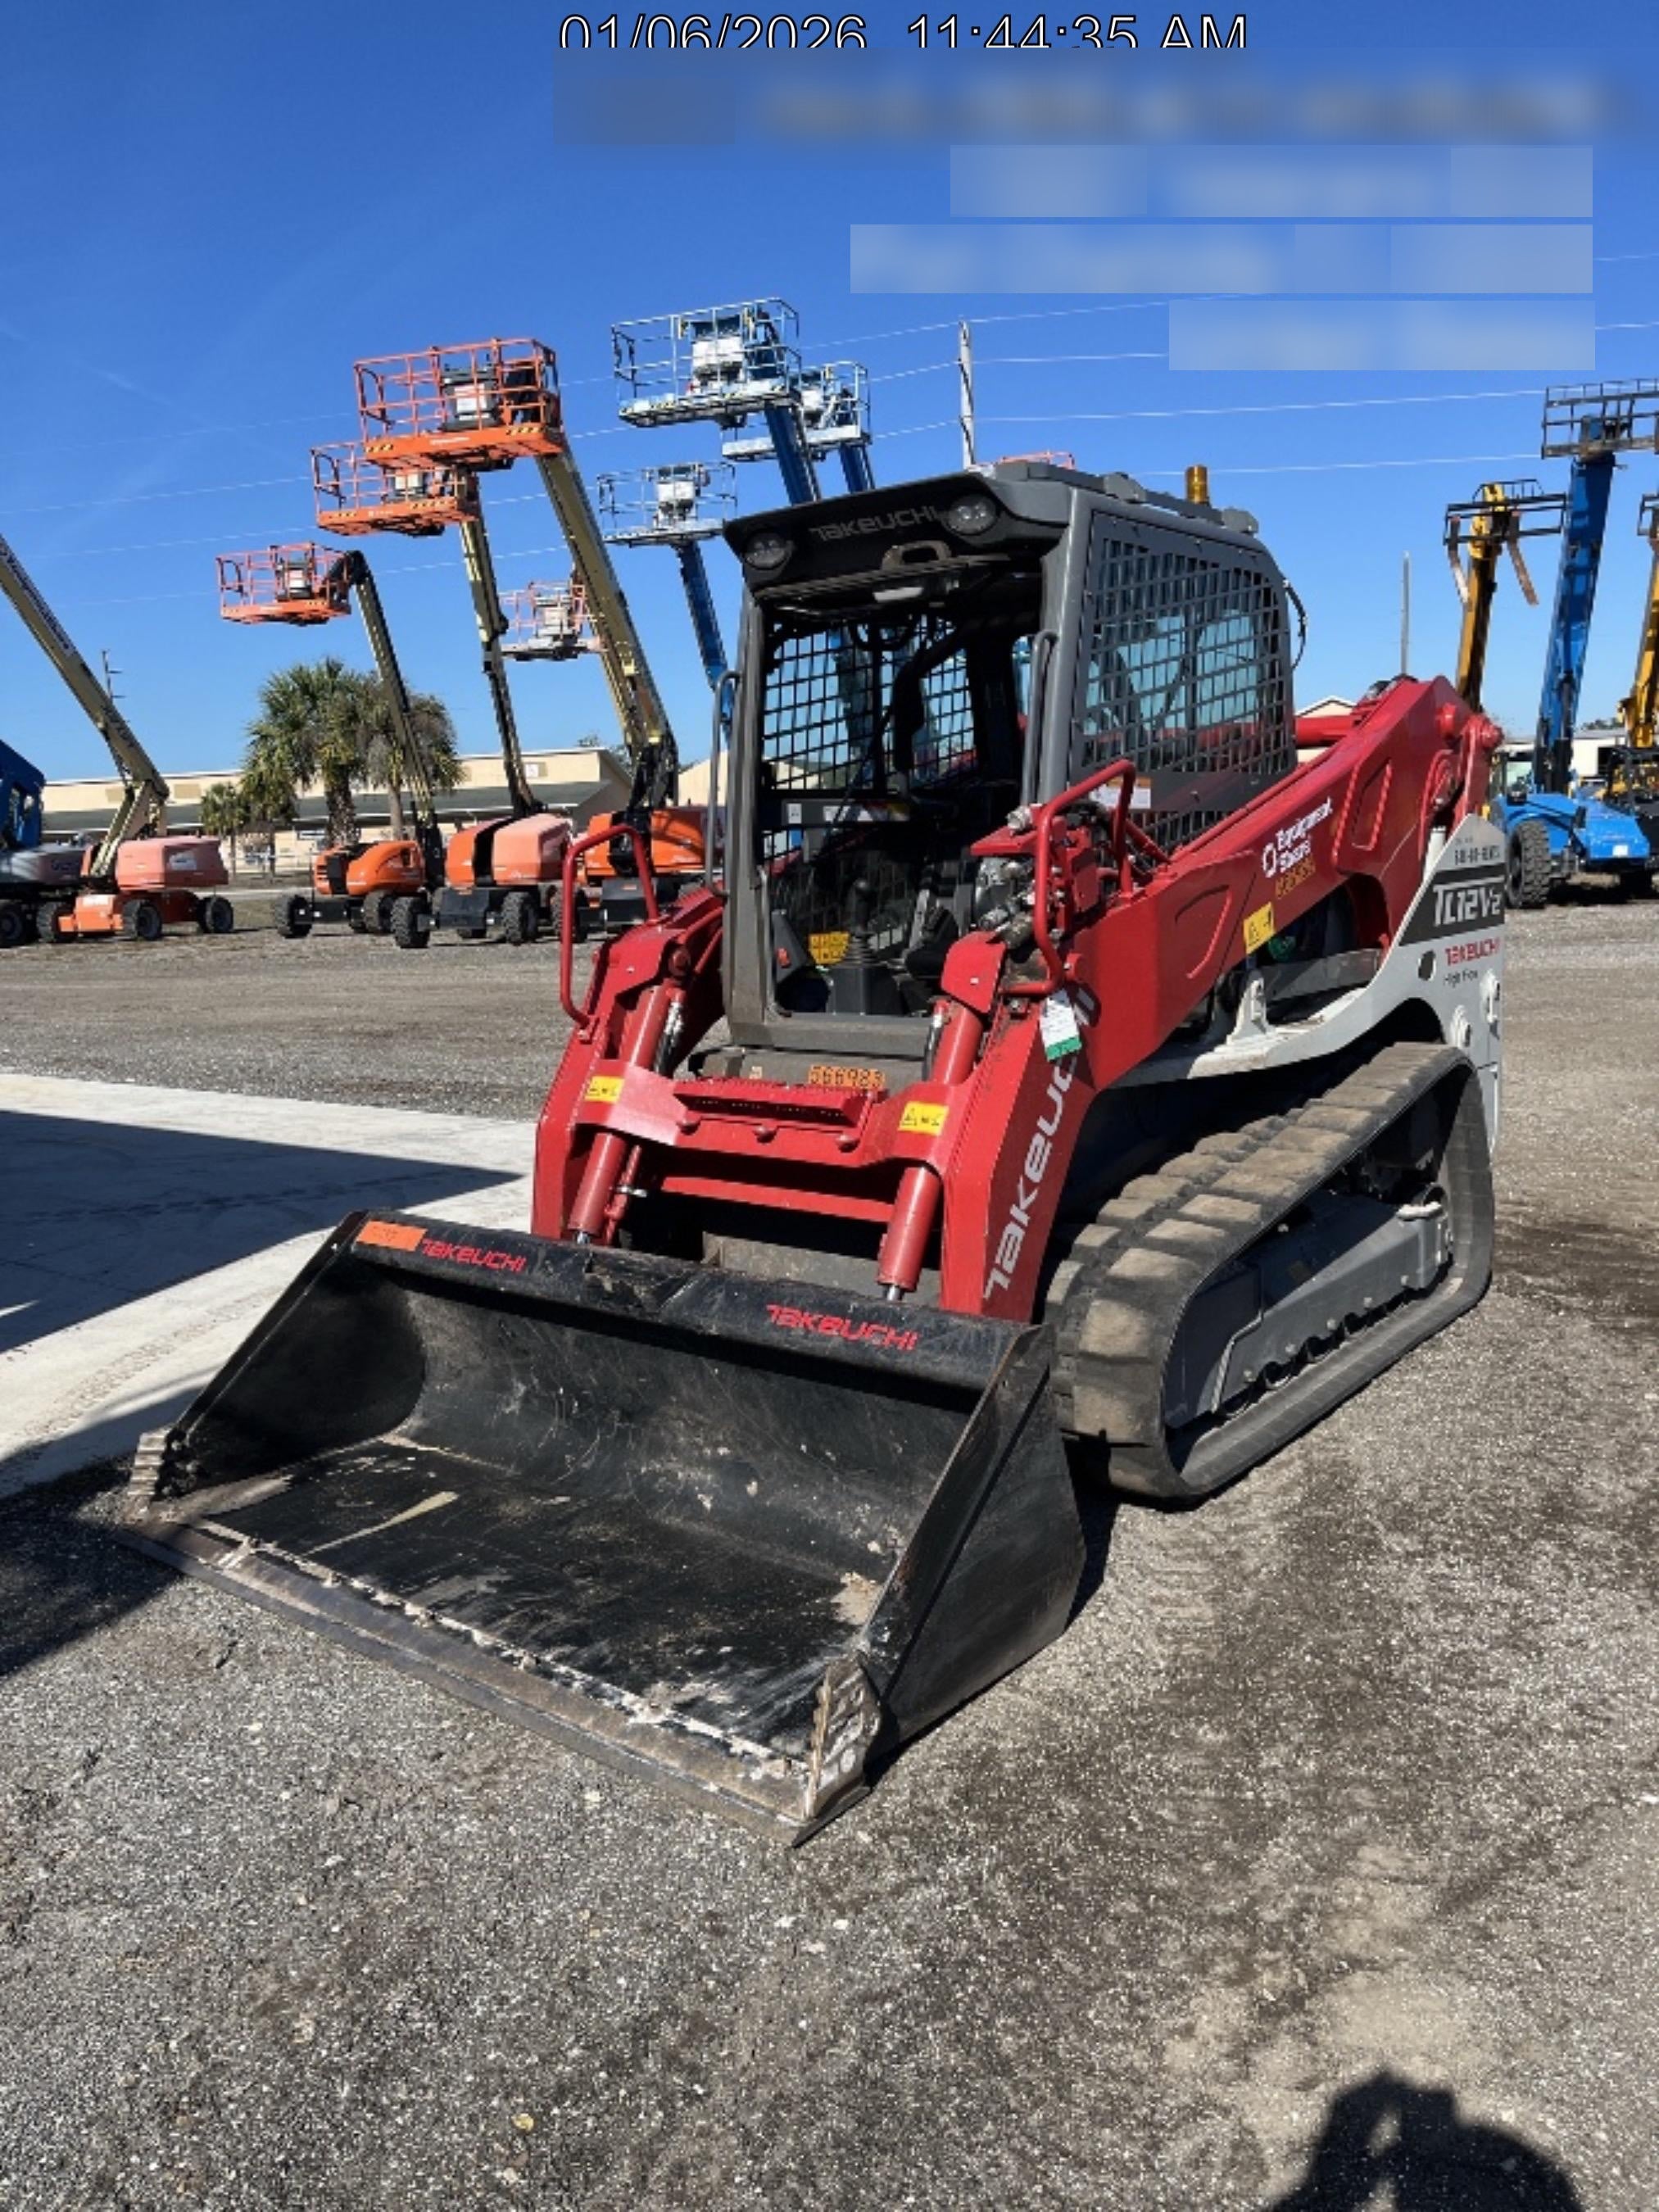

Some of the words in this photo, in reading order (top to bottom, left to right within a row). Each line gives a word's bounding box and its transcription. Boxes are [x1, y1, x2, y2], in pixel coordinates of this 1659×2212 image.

[808, 505, 937, 542] TAKEUCHI
[421, 1238, 527, 1273] TAKEUCHI
[766, 1304, 918, 1351] TAKEUCHI
